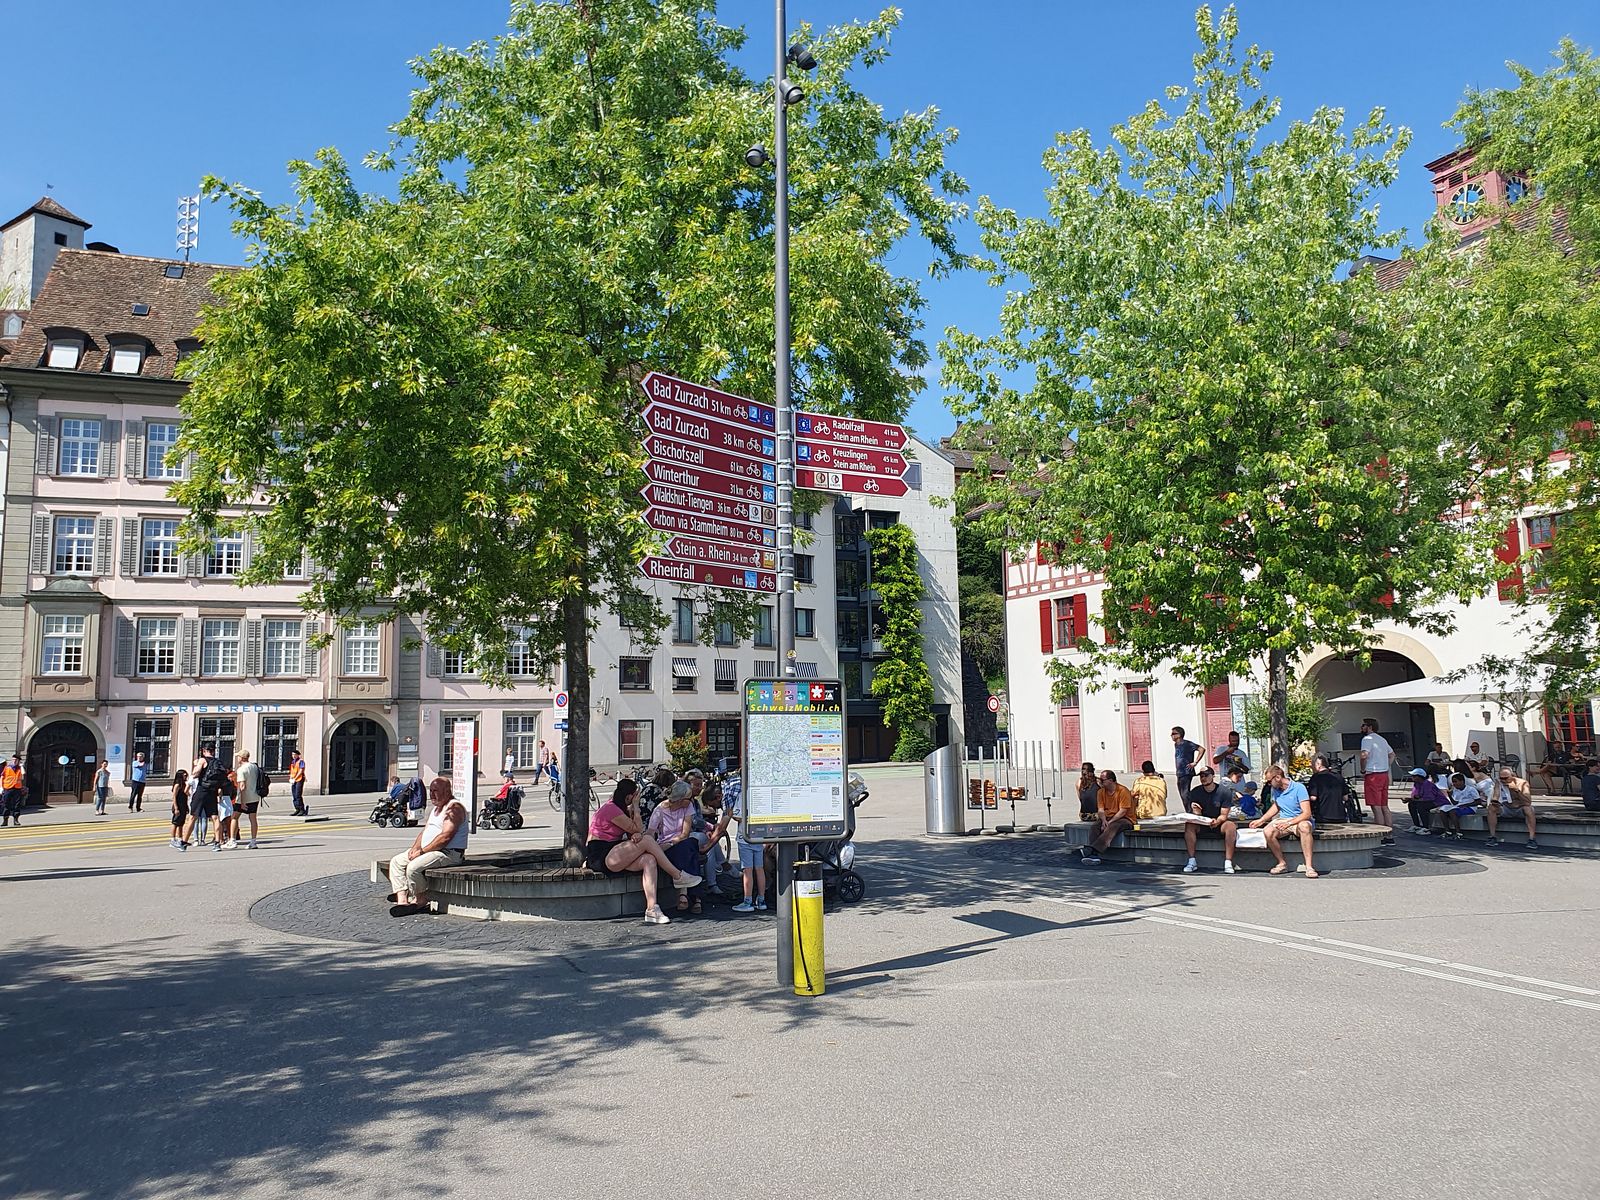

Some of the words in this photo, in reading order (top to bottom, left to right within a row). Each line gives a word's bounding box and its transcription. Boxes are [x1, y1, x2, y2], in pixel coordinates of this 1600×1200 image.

[653, 379, 671, 399] Bad
[674, 385, 709, 409] Zurzach
[711, 400, 719, 412] 51
[720, 403, 731, 416] km
[654, 411, 672, 431] Bad
[675, 416, 709, 440] Zurzach
[723, 433, 732, 444] 38
[733, 436, 744, 449] km
[832, 420, 864, 433] Radolfzell
[890, 429, 899, 437] km
[833, 432, 849, 441] Stein
[849, 434, 860, 442] am
[860, 434, 879, 445] Rhein
[890, 440, 899, 448] km
[653, 440, 704, 464] Bischofszell
[736, 463, 744, 473] km
[832, 448, 868, 461] Kreuzlingen
[833, 460, 849, 469] Stein
[849, 462, 859, 470] am
[859, 462, 876, 473] Rhein
[653, 464, 700, 487] Winterthur
[736, 485, 743, 495] km
[653, 486, 714, 513] Waldshut-Tiengen
[723, 504, 731, 514] km
[653, 511, 675, 527] Arbon
[677, 515, 688, 530] via
[690, 518, 728, 536] Stammheim
[736, 528, 744, 539] km
[675, 540, 697, 557] Stein
[699, 548, 707, 558] a.
[708, 545, 731, 562] Rhein
[732, 555, 739, 564] 34
[740, 556, 748, 564] km
[764, 552, 774, 561] 50
[650, 560, 695, 580] Rheinfall
[731, 575, 735, 584] 4
[735, 575, 743, 585] km
[153, 704, 208, 713] BARIS
[216, 704, 283, 712] KREDIT
[749, 703, 840, 712] SchweizMobil.ch
